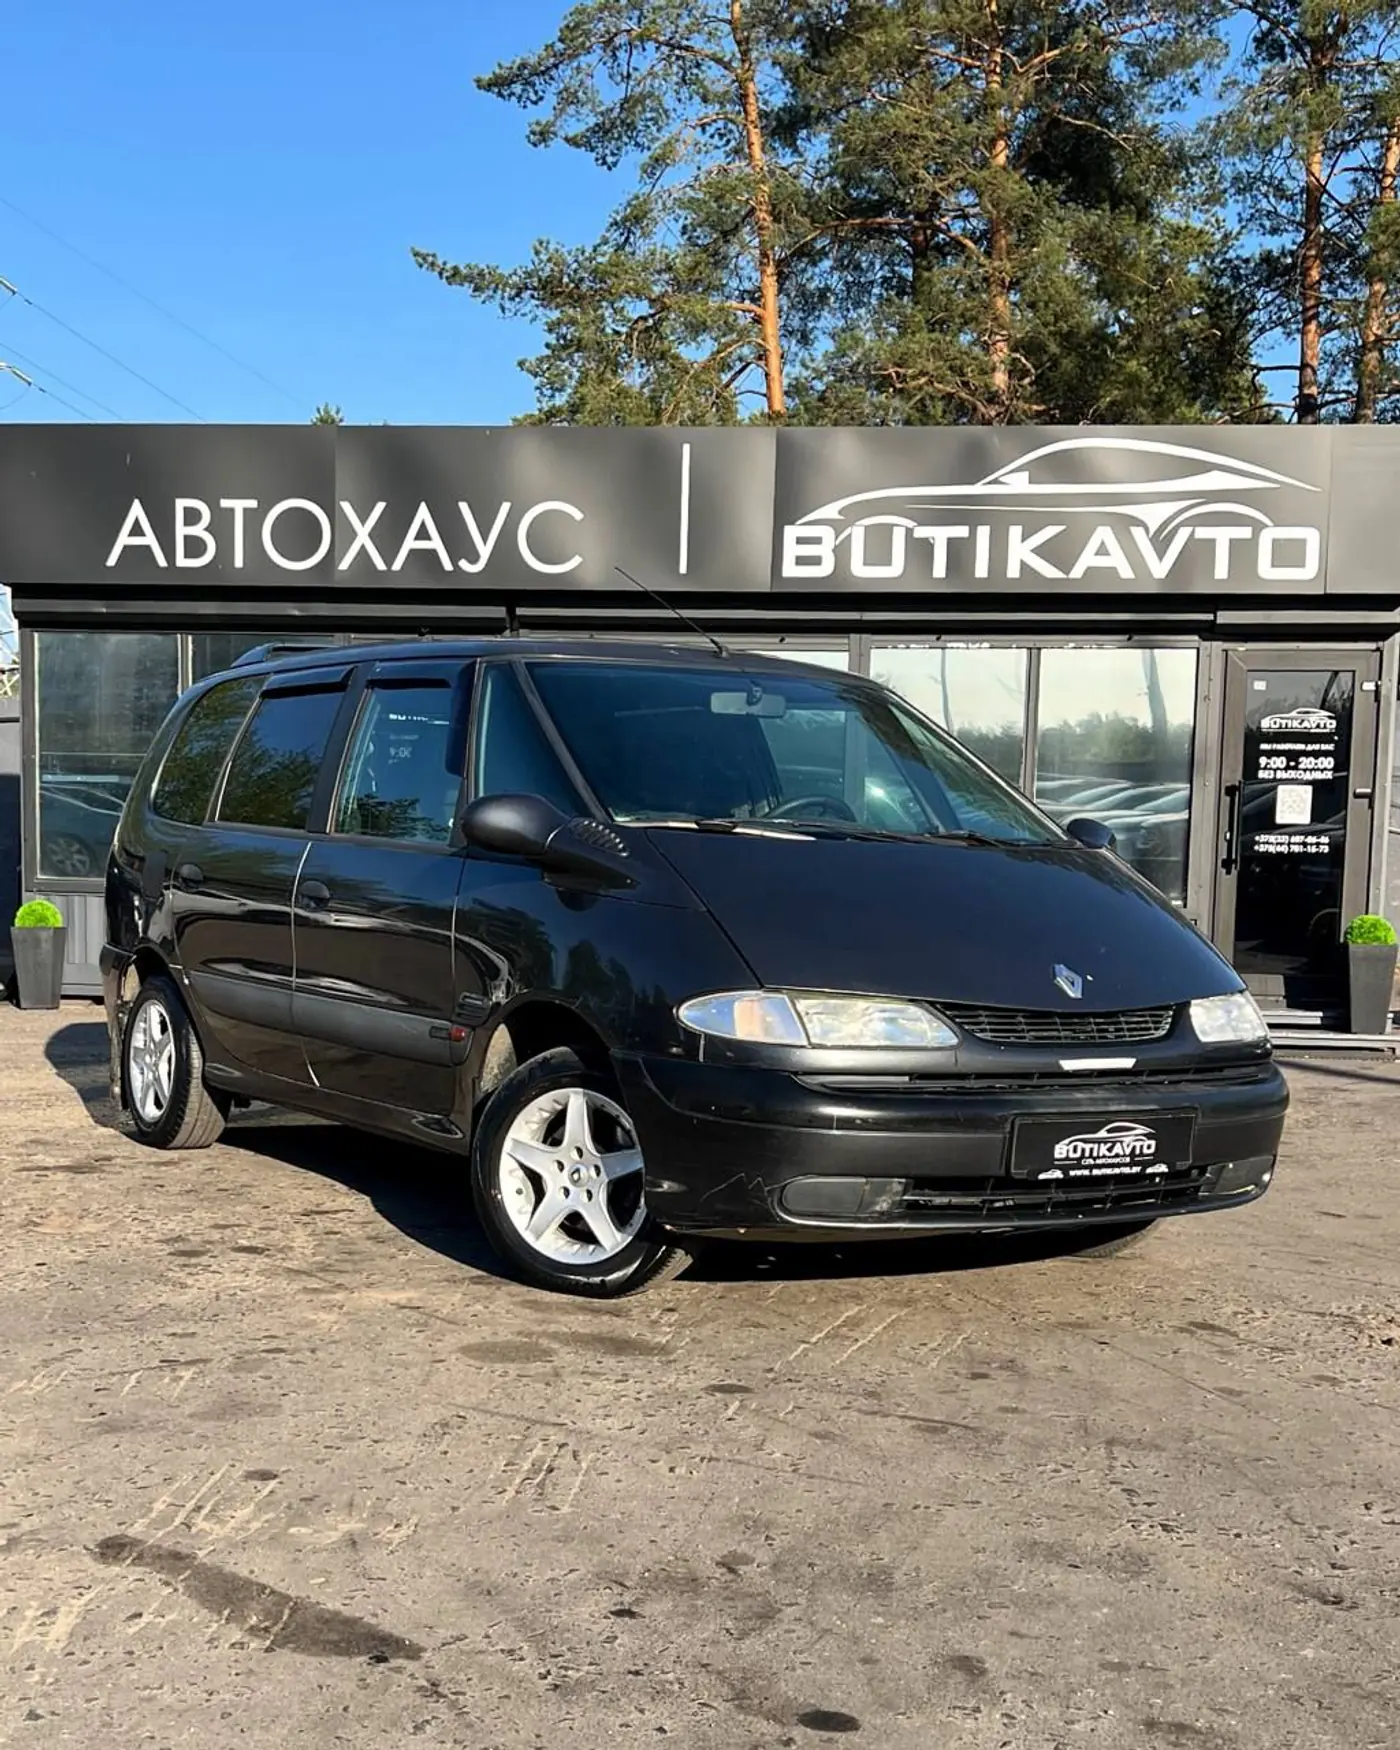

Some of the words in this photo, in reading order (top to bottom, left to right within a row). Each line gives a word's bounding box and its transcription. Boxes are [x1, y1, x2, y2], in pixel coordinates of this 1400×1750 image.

[105, 497, 585, 574] АВТОХАУС
[782, 524, 1322, 580] BUTIKAVTO
[1260, 718, 1337, 729] BUTIKAVTO
[1259, 756, 1287, 769] 9:00
[1298, 756, 1335, 769] 20:00
[1258, 770, 1274, 779] БЕЗ
[1275, 770, 1334, 780] ВЫХОДНЫХ
[1054, 1140, 1157, 1159] BUTIKAVTO
